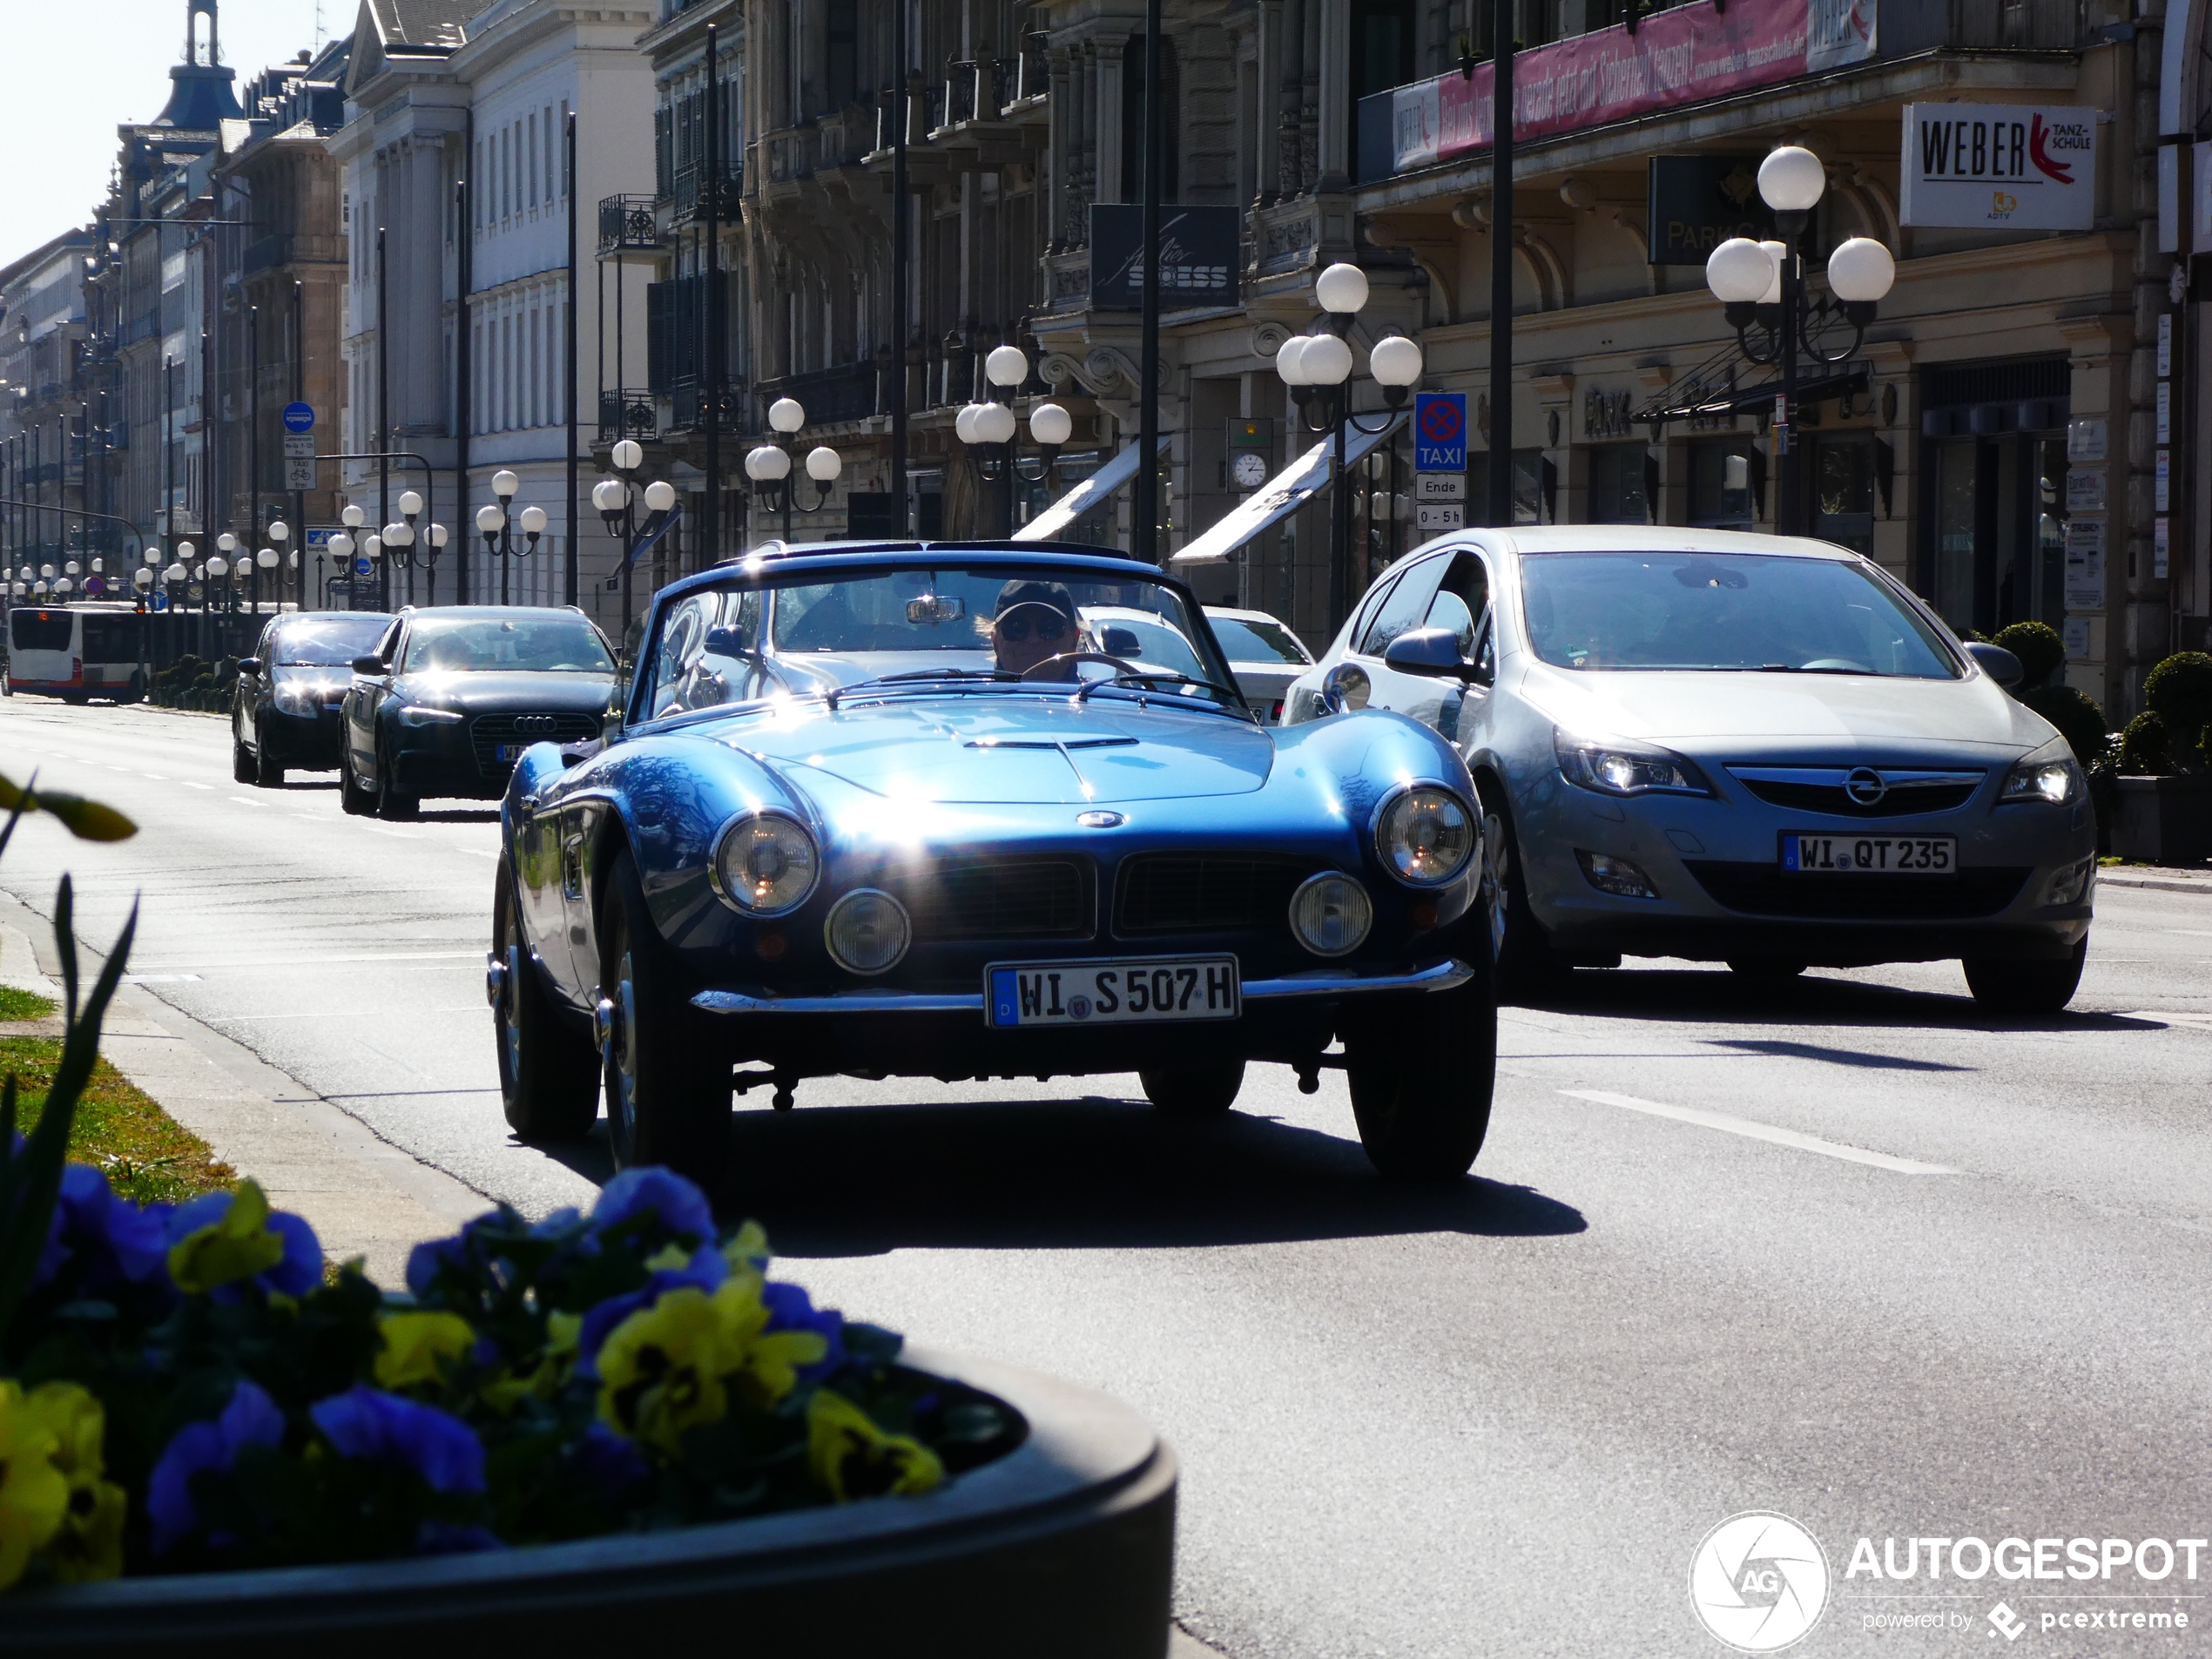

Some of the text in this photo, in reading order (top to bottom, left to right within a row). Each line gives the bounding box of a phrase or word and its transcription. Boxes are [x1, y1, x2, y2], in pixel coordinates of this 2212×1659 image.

[1599, 40, 1652, 107] Sicherheit
[1654, 28, 1694, 92] tanzen!
[2053, 124, 2089, 137] TANZ-
[1921, 120, 2025, 176] WEBER
[2053, 138, 2091, 149] SCHULE
[1420, 448, 1461, 464] TAXI
[1426, 482, 1456, 493] Ende
[1800, 840, 1835, 869] WI
[1019, 974, 1066, 1017] WI
